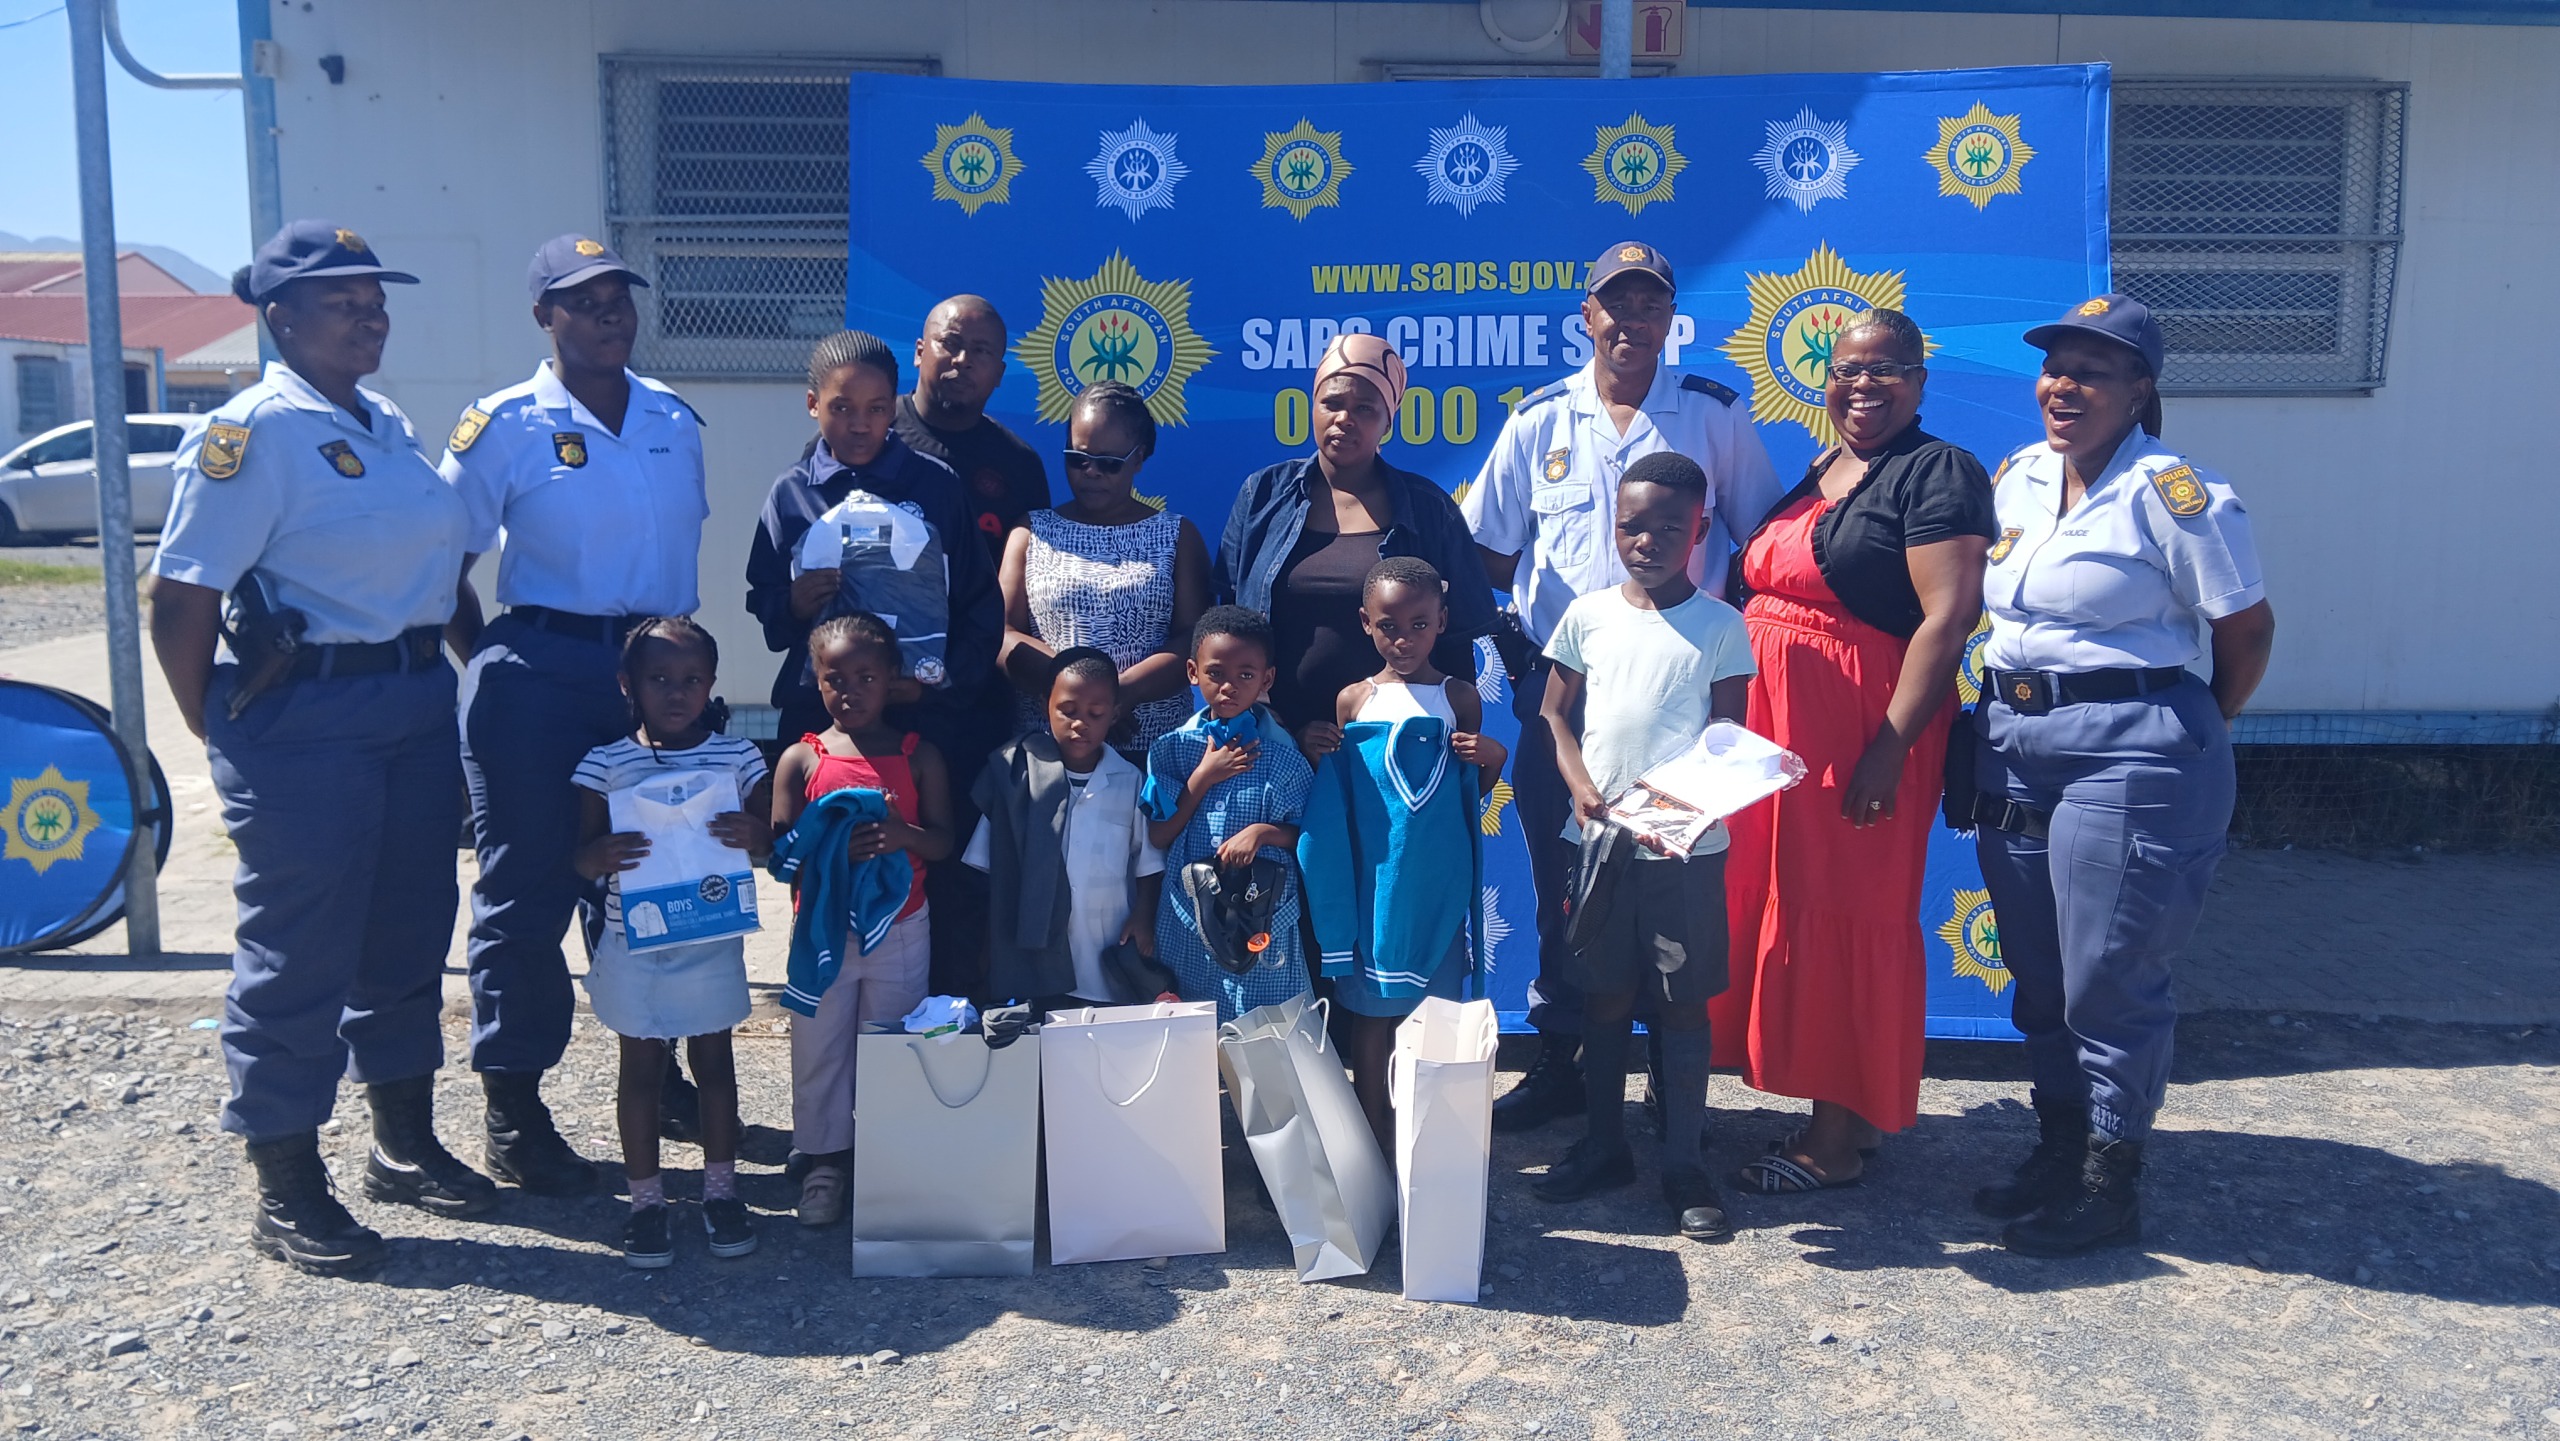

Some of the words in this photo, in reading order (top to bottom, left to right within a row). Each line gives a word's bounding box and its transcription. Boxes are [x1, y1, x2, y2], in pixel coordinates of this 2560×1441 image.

[1440, 138, 1462, 161] SOUTH
[1464, 136, 1496, 160] AFRICAN
[1606, 137, 1629, 160] SOUTH
[1632, 136, 1665, 159] AFRICAN
[1777, 132, 1800, 155] SOUTH
[1802, 131, 1835, 155] AFRICAN
[1950, 128, 1973, 152] SOUTH
[1976, 126, 2010, 150] AFRICAN
[1274, 143, 1297, 166] SOUTH
[1299, 141, 1331, 165] AFRICAN
[1440, 174, 1463, 193] POLICE
[1607, 172, 1631, 192] POLICE
[1633, 171, 1663, 193] SERVICE
[1778, 168, 1802, 188] POLICE
[1805, 168, 1835, 189] SERVICE
[1951, 165, 1976, 185] POLICE
[1275, 178, 1297, 198] POLICE
[1060, 300, 1103, 343] SOUTH
[1110, 298, 1169, 345] AFRICAN
[1771, 294, 1814, 339] SOUTH
[1386, 314, 1549, 367] CRIME
[1775, 365, 1823, 403] POLICE
[2157, 467, 2190, 486] POLICE
[1964, 634, 1986, 658] SOUTH
[666, 898, 693, 913] BOYS
[1964, 903, 1989, 928] SOUTH
[1966, 943, 1993, 967] POLICE
